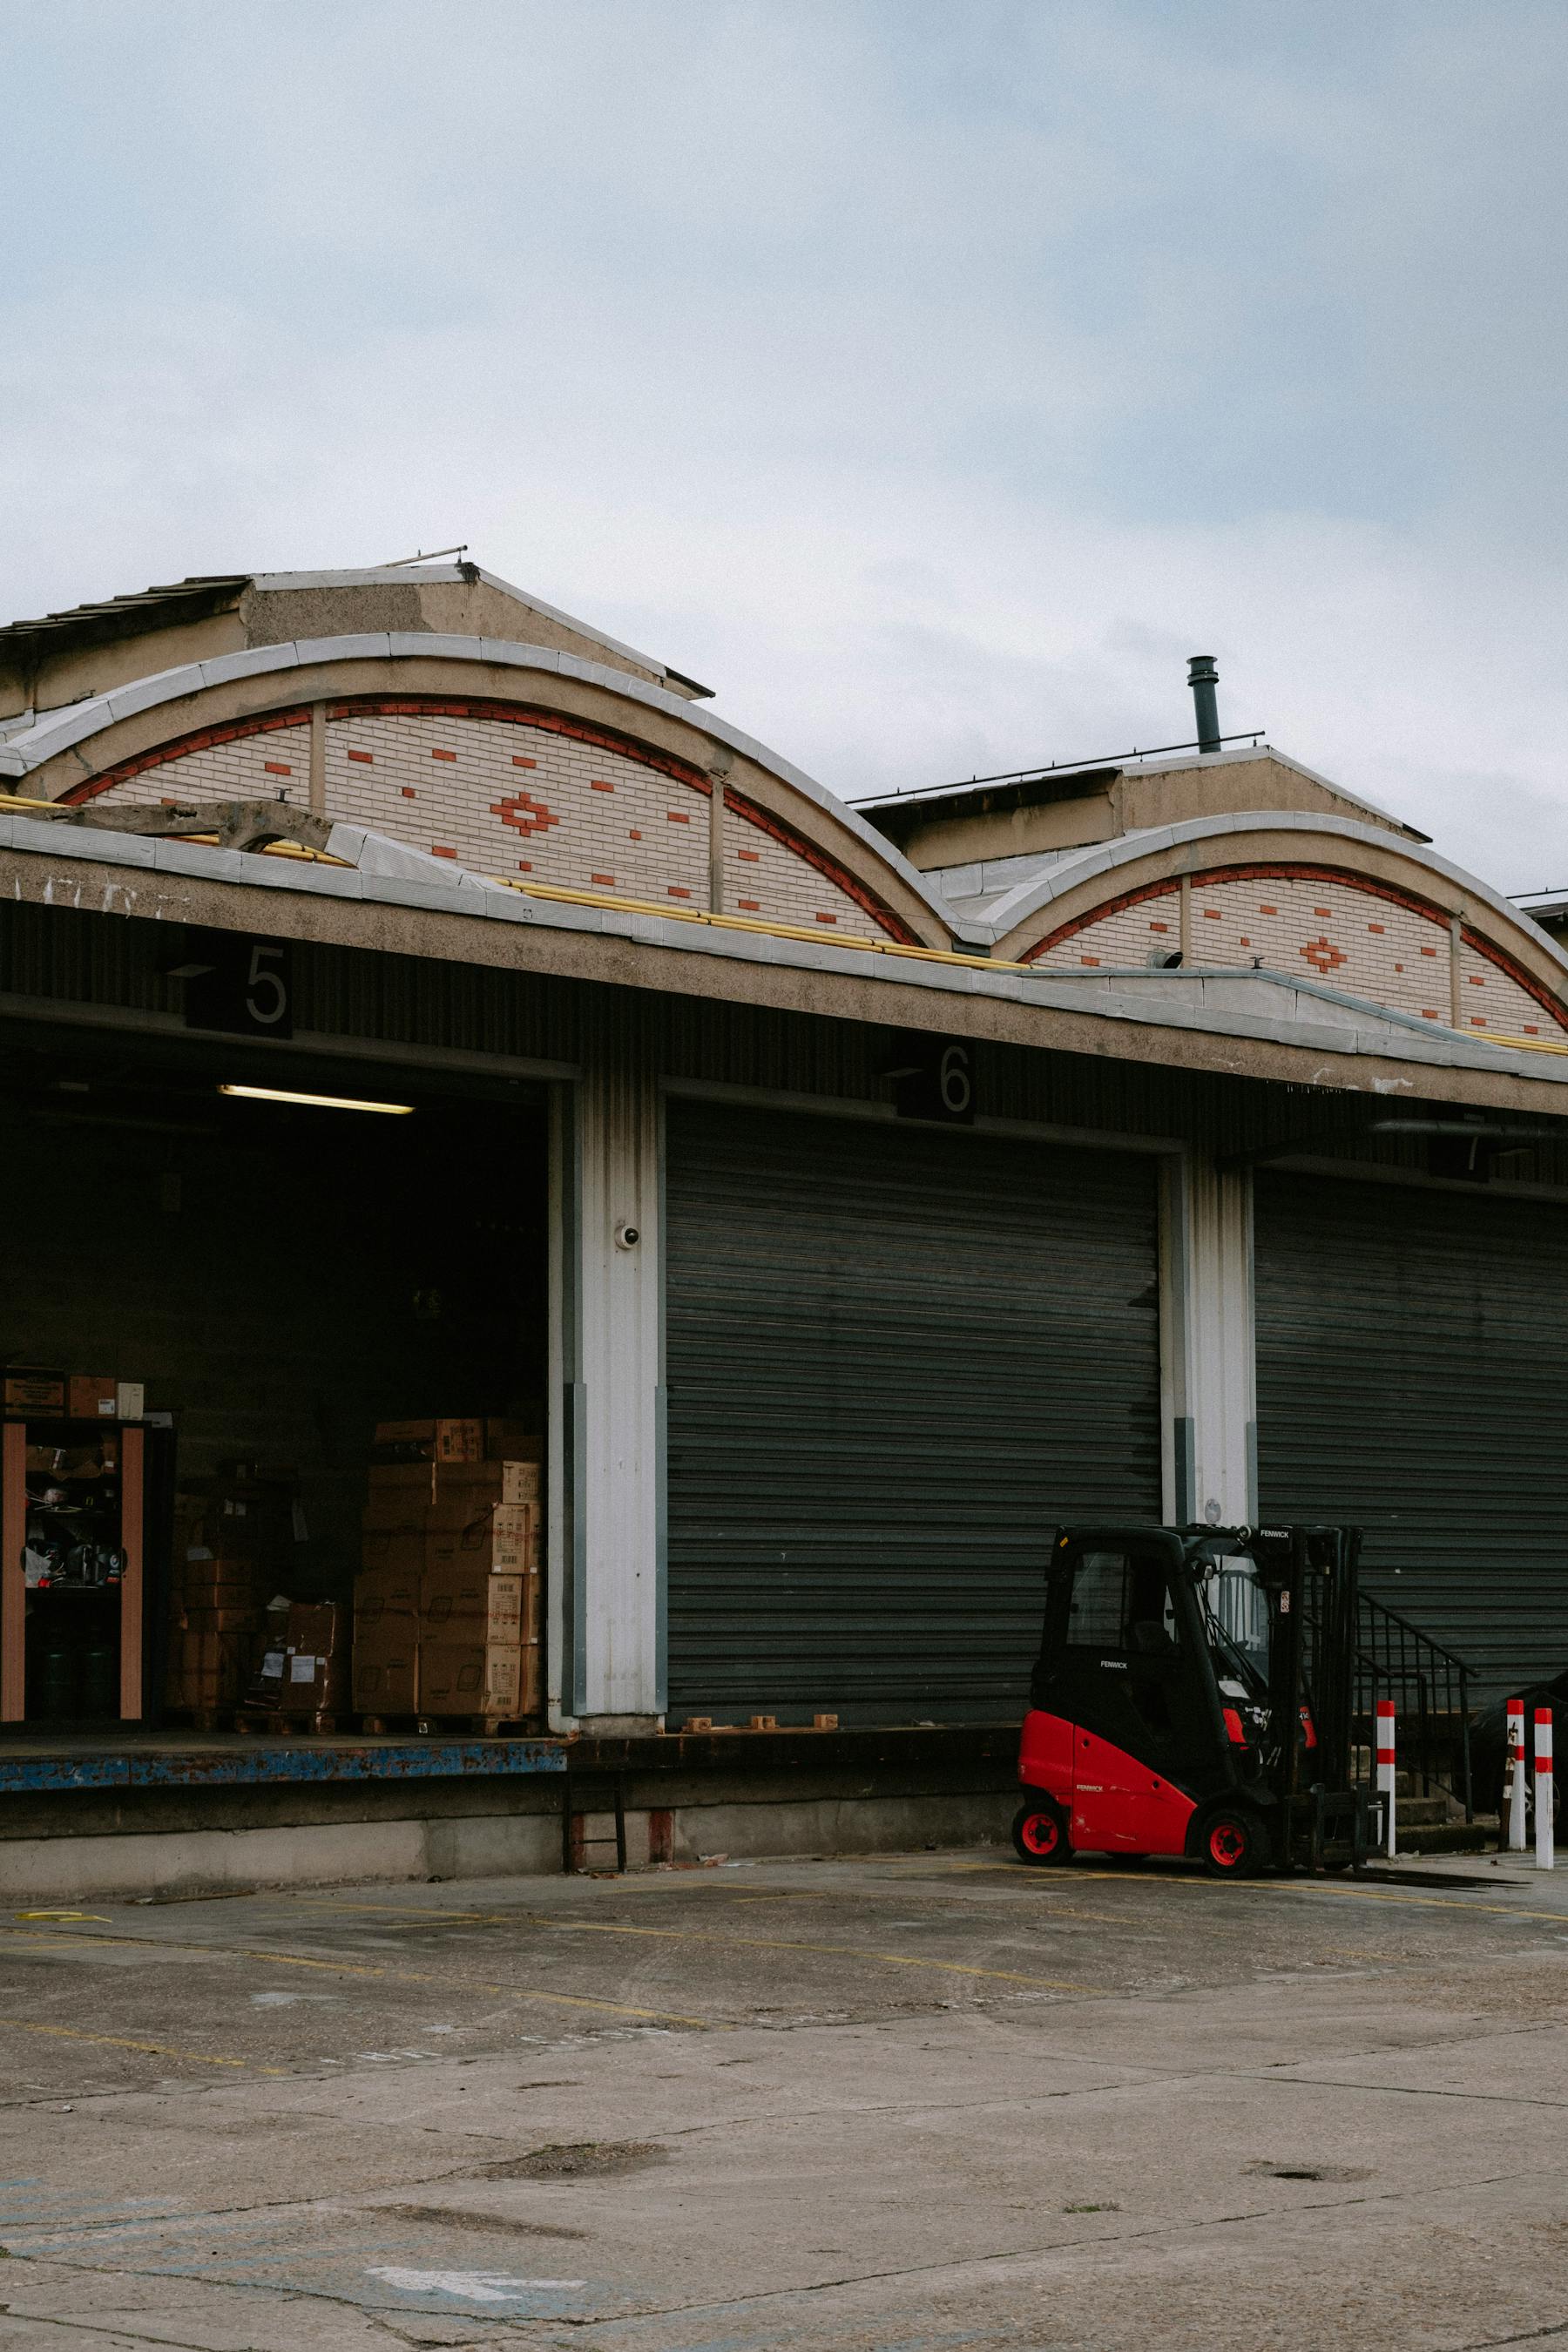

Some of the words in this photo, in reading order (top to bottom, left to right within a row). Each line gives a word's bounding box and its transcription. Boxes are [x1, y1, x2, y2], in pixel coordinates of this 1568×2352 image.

[246, 944, 287, 1024] 5
[941, 1045, 970, 1112] 6
[1260, 1529, 1289, 1539] FENWICK
[1101, 1659, 1127, 1670] FENWICK
